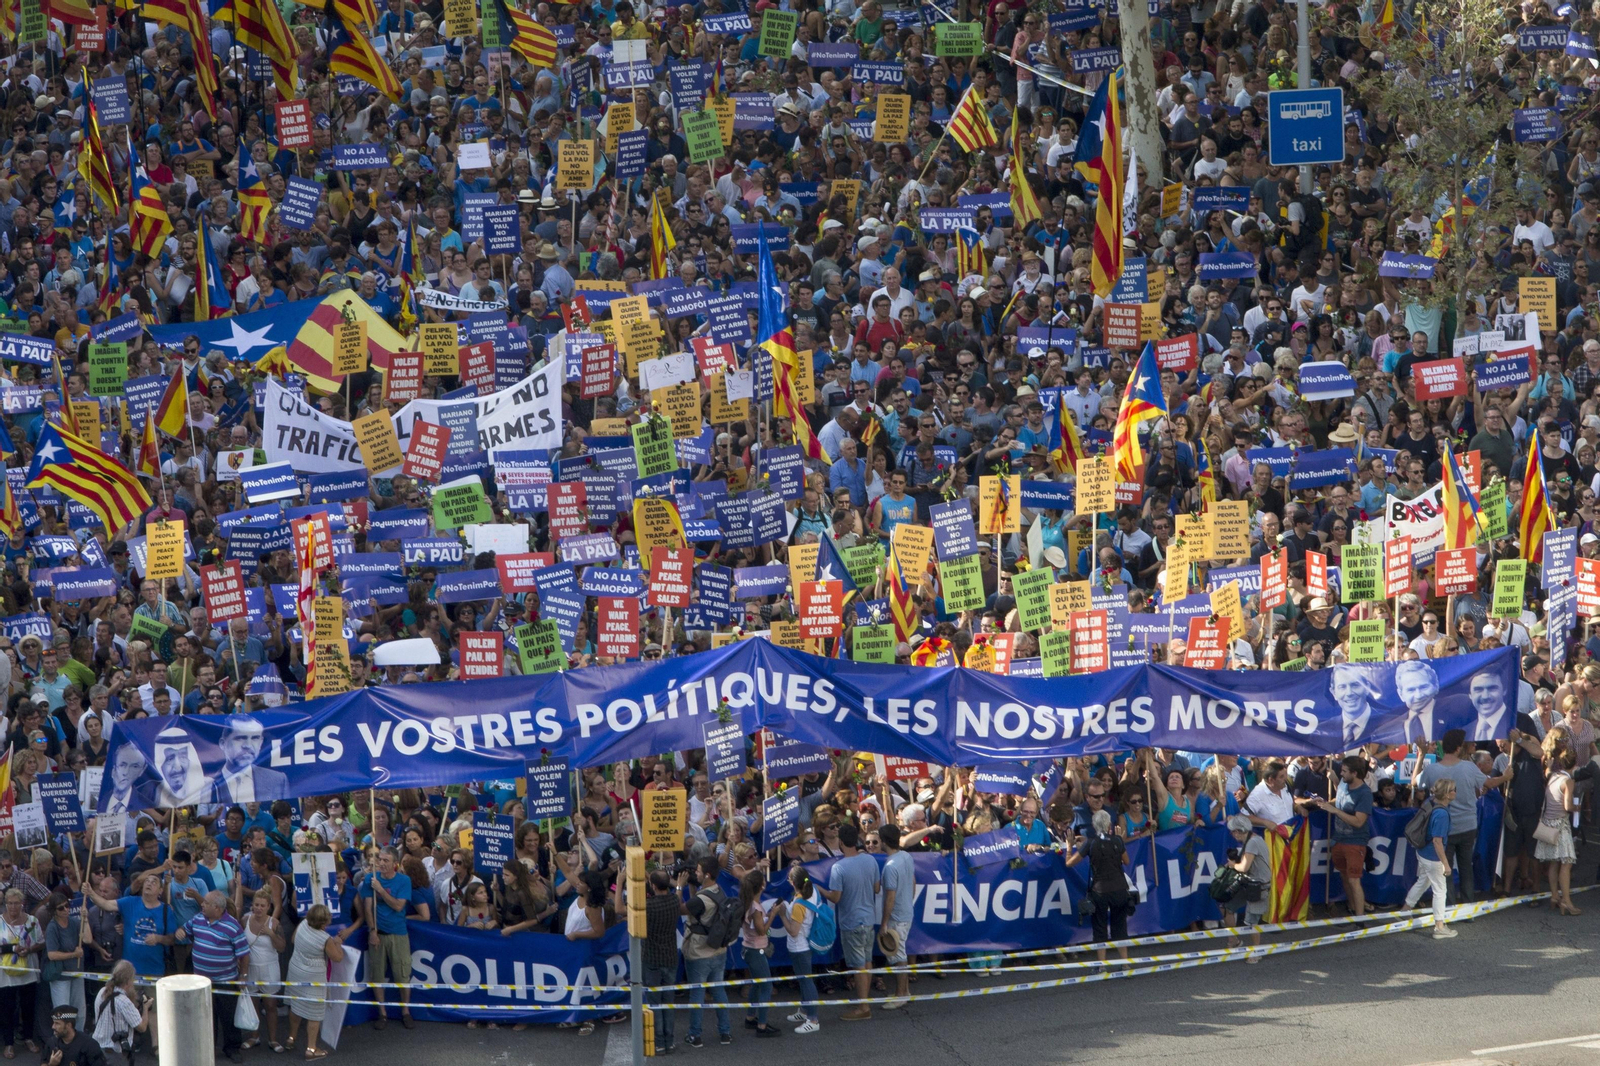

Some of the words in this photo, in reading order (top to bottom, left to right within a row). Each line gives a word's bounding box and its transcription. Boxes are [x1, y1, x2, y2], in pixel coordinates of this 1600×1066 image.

[705, 22, 722, 31] LA
[725, 19, 752, 30] PAU
[1520, 36, 1536, 46] LA
[1540, 35, 1566, 46] PAU
[854, 69, 870, 80] LA
[875, 70, 903, 82] PAU
[280, 105, 304, 115] VOLEM
[281, 116, 295, 125] PAU,
[296, 115, 306, 123] NO
[281, 124, 308, 135] VENDRE
[283, 135, 309, 145] ARMES!
[1292, 137, 1322, 152] taxi
[336, 156, 388, 166] ISLAMOFÒBIA
[708, 293, 742, 305] MARIANO,
[1110, 308, 1136, 316] VOLEM
[716, 313, 740, 322] PEACE,
[1109, 318, 1124, 326] PAU,
[721, 330, 742, 339] SALES
[1108, 327, 1137, 336] VENDRE
[1108, 337, 1137, 346] ARMES!
[587, 350, 609, 361] VOLEM
[393, 358, 419, 366] VOLEM
[586, 363, 600, 372] PAU,
[601, 361, 610, 370] NO
[392, 369, 407, 377] PAU,
[408, 368, 418, 376] NO
[1421, 366, 1443, 376] VOLEM
[585, 372, 610, 384] VENDRE
[1424, 377, 1433, 385] NO
[1433, 373, 1458, 384] VENDRE
[1478, 372, 1529, 387] ISLAMOFÒBIA
[390, 379, 419, 388] VENDRE
[585, 382, 610, 395] ARMES!
[1430, 382, 1455, 393] ARMES!
[512, 373, 549, 405] NO
[390, 390, 417, 399] ARMES!
[478, 408, 555, 449] ARMES
[243, 475, 295, 488] #NoTenimPor
[312, 482, 365, 493] #NoTenimPor
[668, 551, 679, 559] WE
[1346, 548, 1378, 557] IMAGINA
[662, 561, 682, 570] WANT
[1360, 558, 1377, 567] PAÍS
[1446, 559, 1466, 567] WANT
[207, 567, 235, 581] VOLEM
[1349, 570, 1364, 578] QUE
[1453, 574, 1474, 583] ARMS
[209, 582, 226, 594] PAU,
[227, 580, 237, 590] NO
[652, 583, 666, 591] NOT
[666, 584, 688, 593] ARMS
[1348, 580, 1374, 589] VENGUI
[1445, 584, 1467, 593] SALES
[209, 591, 241, 606] VENDRE
[658, 594, 680, 604] SALES
[1349, 590, 1374, 599] ARMES
[212, 604, 243, 618] ARMES!
[270, 725, 344, 767] LES
[357, 708, 563, 758] VOSTRES
[863, 696, 938, 735] LES
[955, 696, 1156, 740] NOSTRES
[1169, 694, 1319, 734] MORTS
[529, 765, 566, 774] MARIANO
[534, 773, 561, 781] VOLEM
[533, 797, 565, 806] VENDRE
[535, 805, 563, 814] ARMES
[1167, 851, 1218, 900] LA
